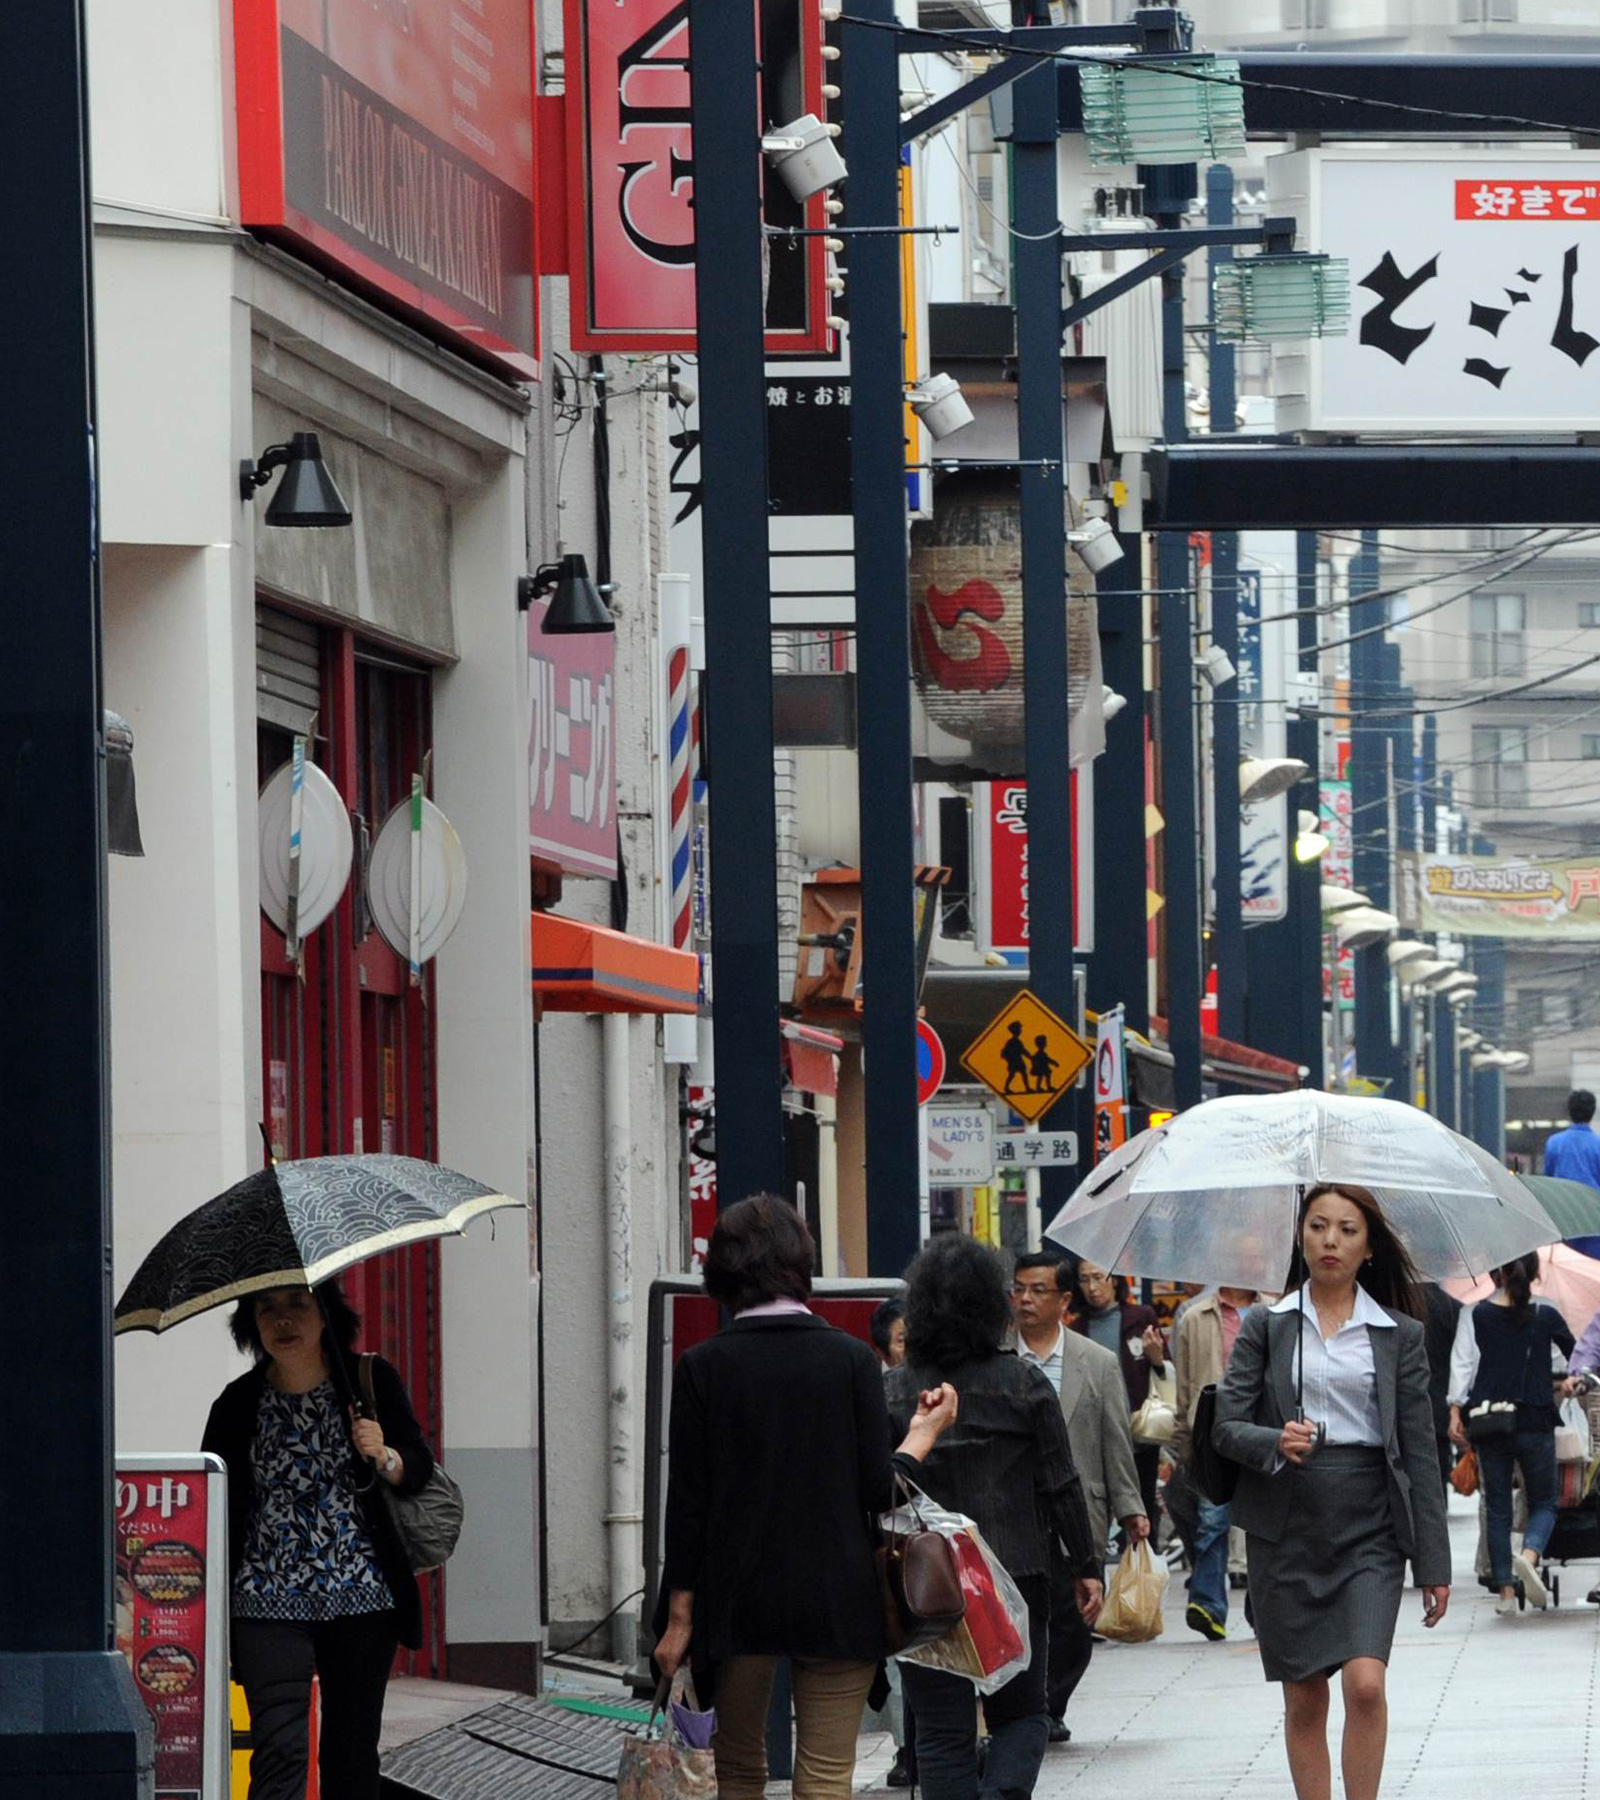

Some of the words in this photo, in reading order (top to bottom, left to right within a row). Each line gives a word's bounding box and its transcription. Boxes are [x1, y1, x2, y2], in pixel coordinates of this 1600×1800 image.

[931, 1116, 973, 1129] MEN'S
[942, 1130, 985, 1142] LADY'S
[996, 1139, 1072, 1161] 通学路
